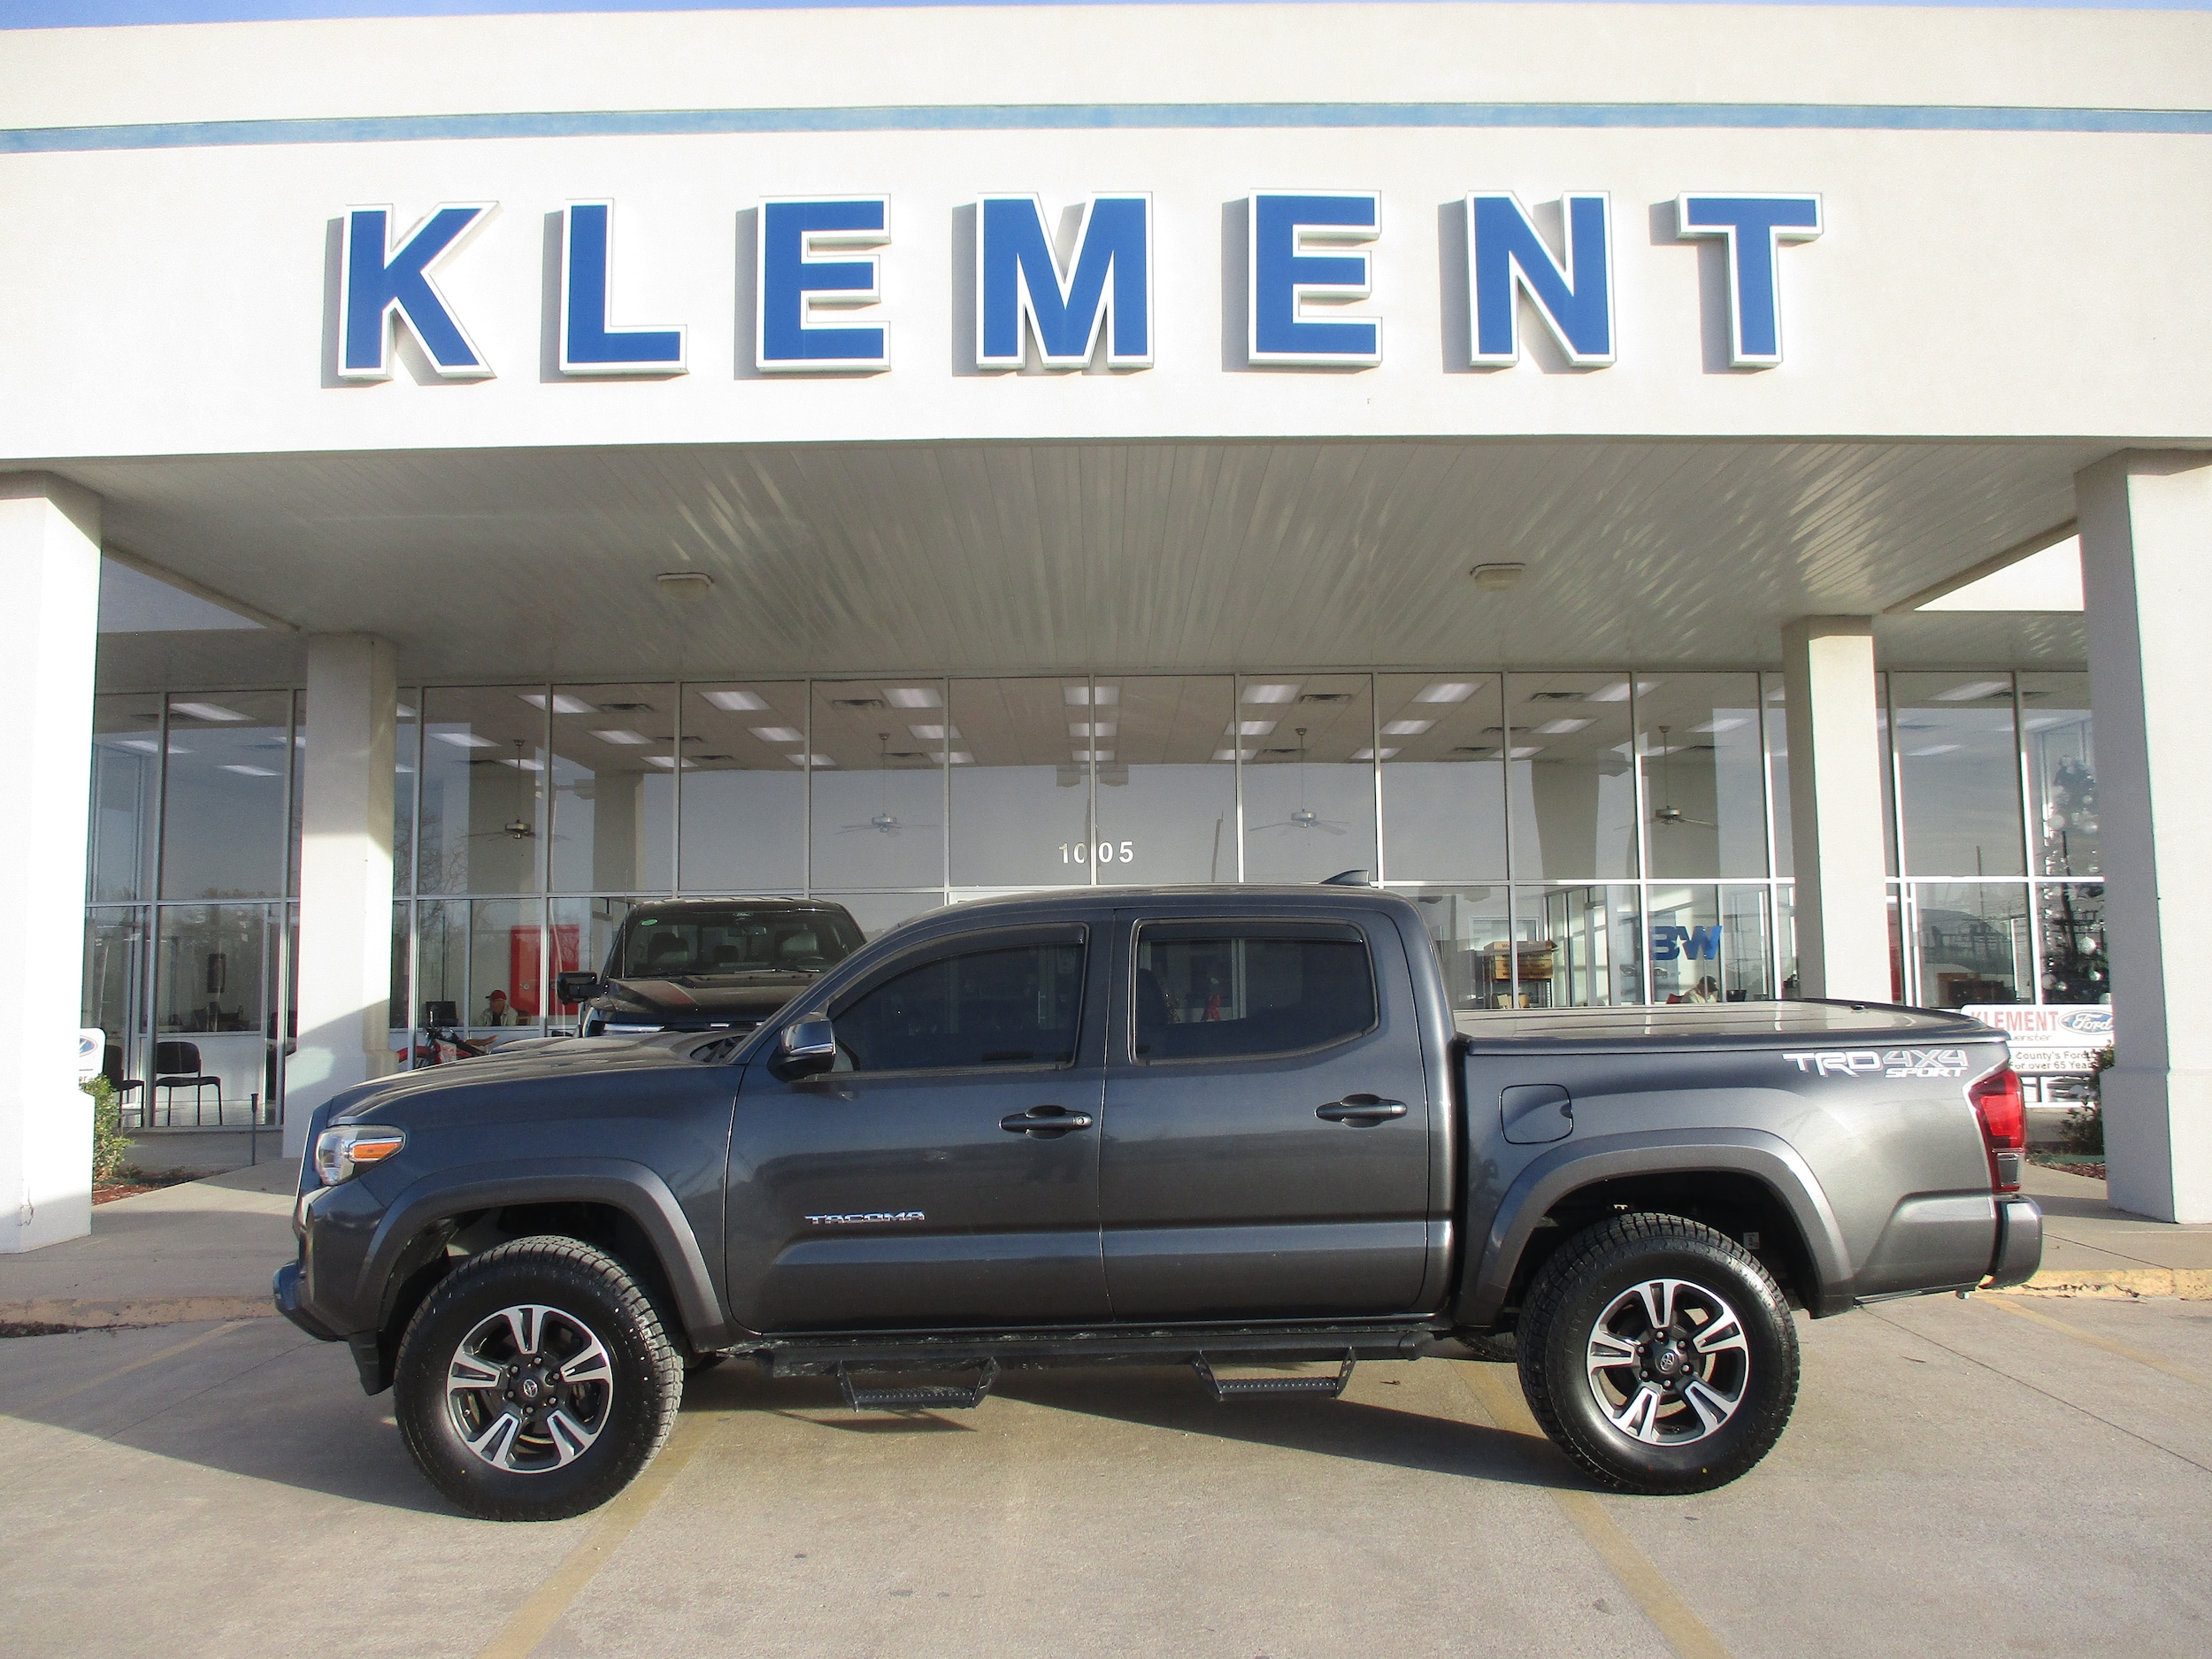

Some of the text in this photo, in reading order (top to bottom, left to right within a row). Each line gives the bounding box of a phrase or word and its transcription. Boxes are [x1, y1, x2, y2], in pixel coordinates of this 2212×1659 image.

[338, 188, 1824, 380] KLEMENT
[1058, 841, 1134, 864] 1005
[2015, 1050, 2061, 1061] County's
[1781, 1050, 1883, 1078] TRD
[2054, 1061, 2066, 1070] 65
[2069, 1061, 2091, 1070] Year
[1885, 1066, 1969, 1078] SPORT
[804, 1210, 926, 1225] TACOMA
